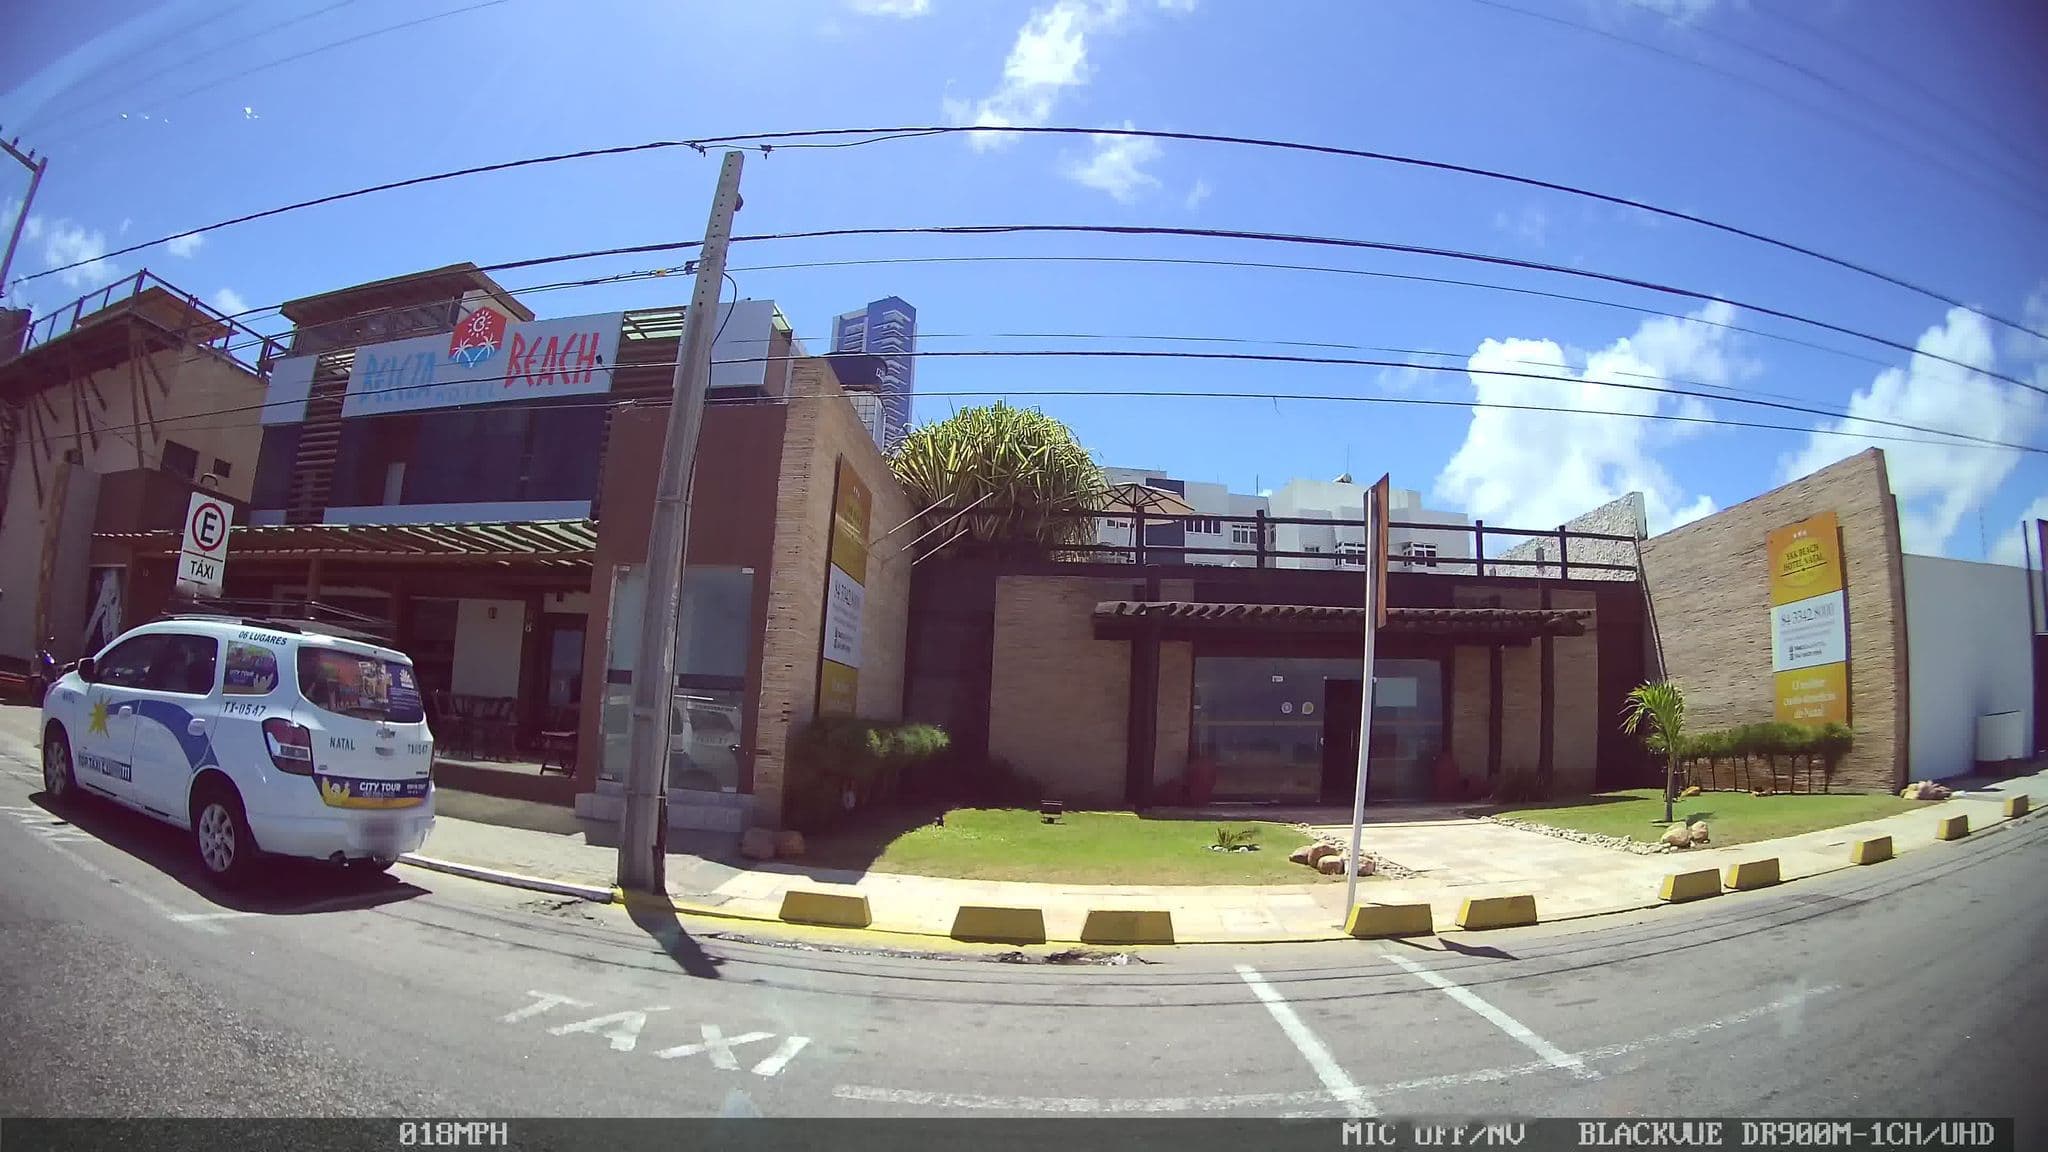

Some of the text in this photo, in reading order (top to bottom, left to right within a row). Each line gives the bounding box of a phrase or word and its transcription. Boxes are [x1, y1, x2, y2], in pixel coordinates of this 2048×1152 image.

[503, 331, 600, 389] BEACH
[200, 511, 217, 544] E
[190, 559, 215, 580] TÁXI
[238, 630, 288, 646] 06 LUGARES
[329, 736, 355, 751] NATAL
[359, 781, 380, 792] CITY
[380, 783, 401, 793] TOUR
[496, 989, 812, 1077] TAXI
